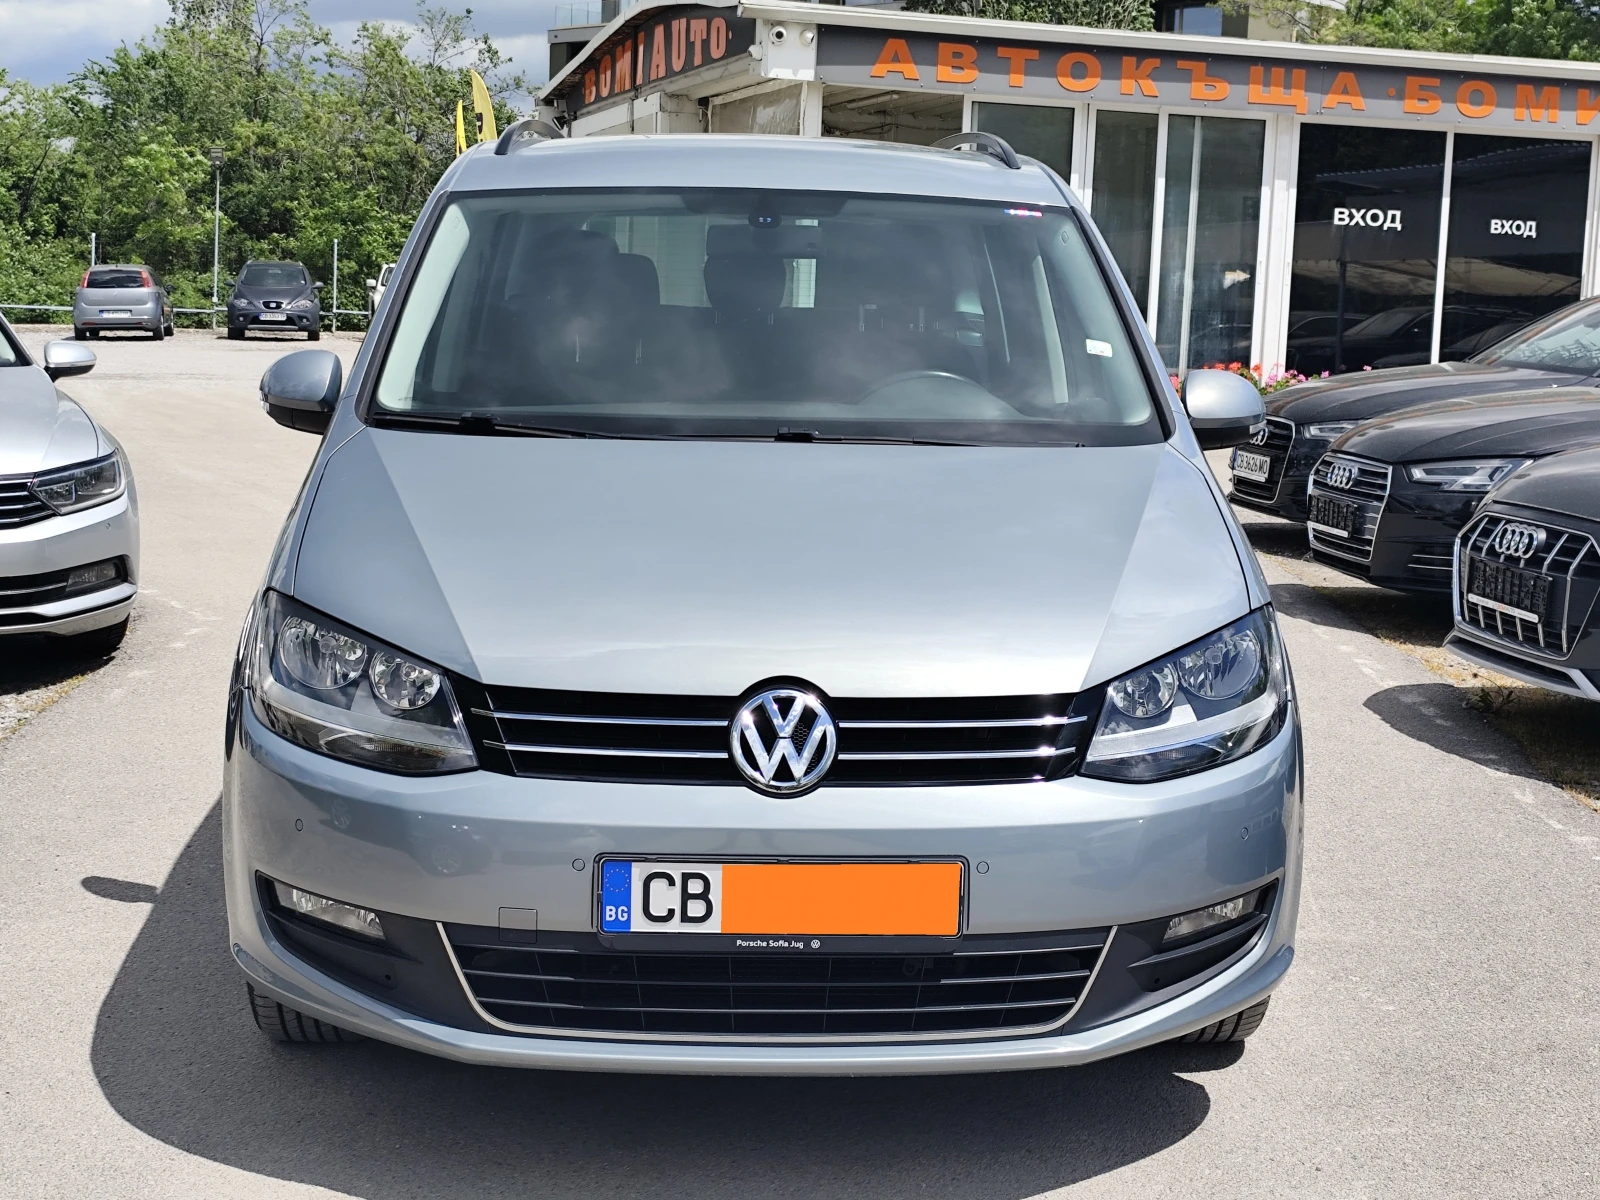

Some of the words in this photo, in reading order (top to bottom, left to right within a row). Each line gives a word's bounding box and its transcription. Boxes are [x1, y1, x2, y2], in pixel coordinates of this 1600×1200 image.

[870, 38, 1367, 115] АВТОКЪЩА
[1333, 207, 1402, 231] ВХОД
[1490, 219, 1537, 238] ВХОД
[604, 905, 629, 922] BG
[641, 870, 715, 925] CB
[736, 939, 768, 947] Porsche
[768, 939, 789, 948] Sofia
[789, 940, 804, 950] Jug
